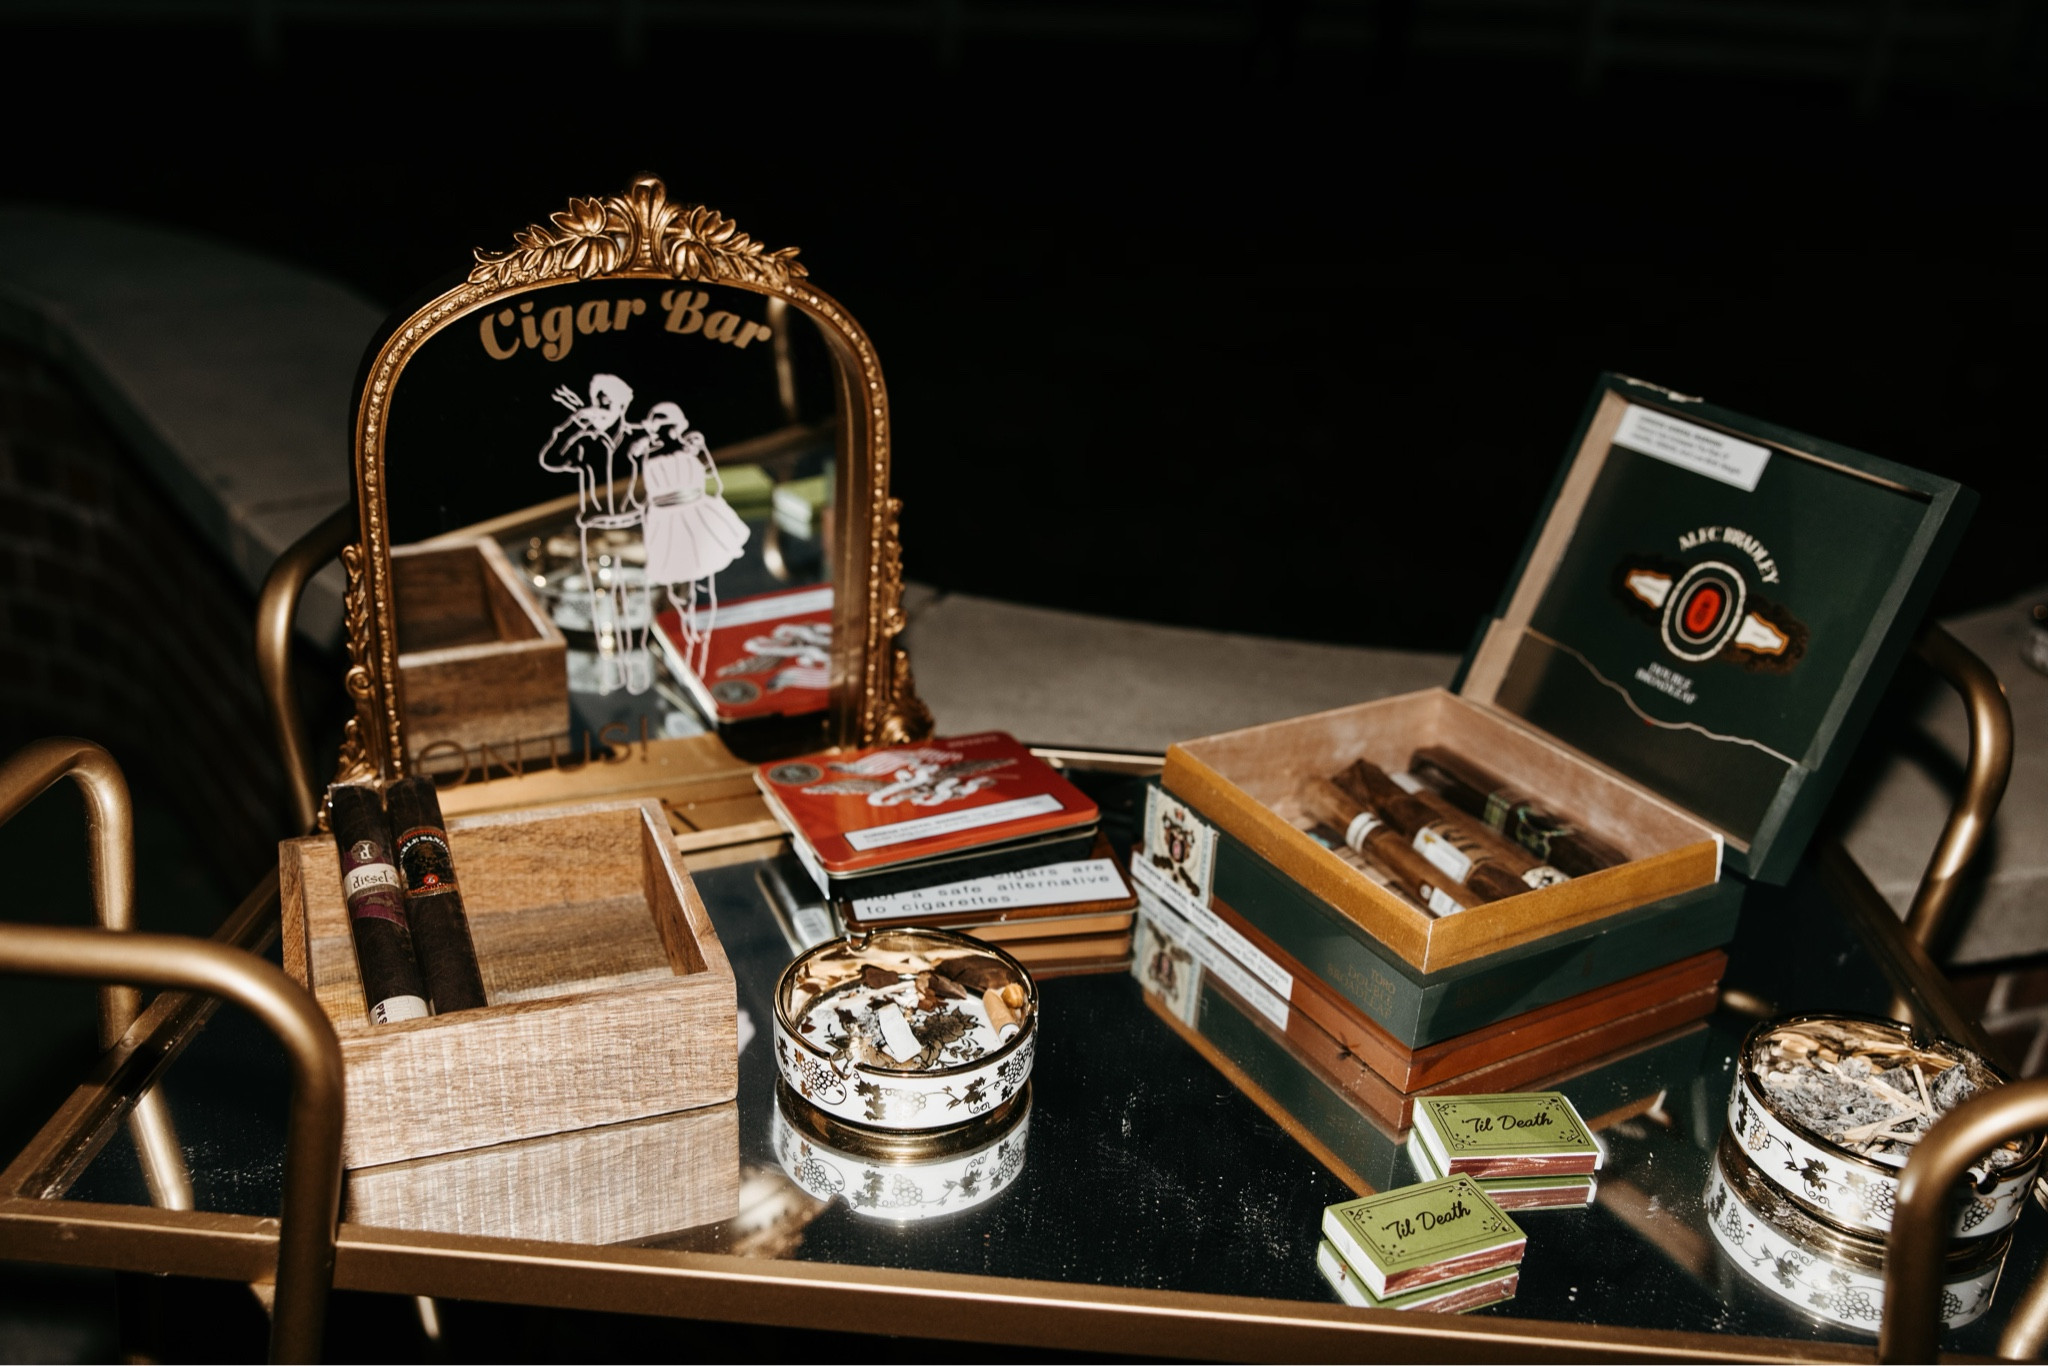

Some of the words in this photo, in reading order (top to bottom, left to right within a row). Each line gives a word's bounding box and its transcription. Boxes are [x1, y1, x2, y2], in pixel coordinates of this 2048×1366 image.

[479, 299, 647, 362] Cigar
[660, 289, 772, 349] Bar
[353, 870, 389, 889] diesel
[1072, 863, 1105, 873] are
[911, 890, 923, 899] a
[938, 885, 982, 897] safe
[997, 873, 1111, 892] alternative
[867, 904, 887, 915] to
[902, 895, 1019, 911] cigarettes.
[1372, 968, 1396, 995] TORO
[1461, 1116, 1494, 1133] 'Til
[1497, 1112, 1554, 1131] Death
[1381, 1218, 1416, 1241] 'Til
[1416, 1201, 1471, 1231] Death
